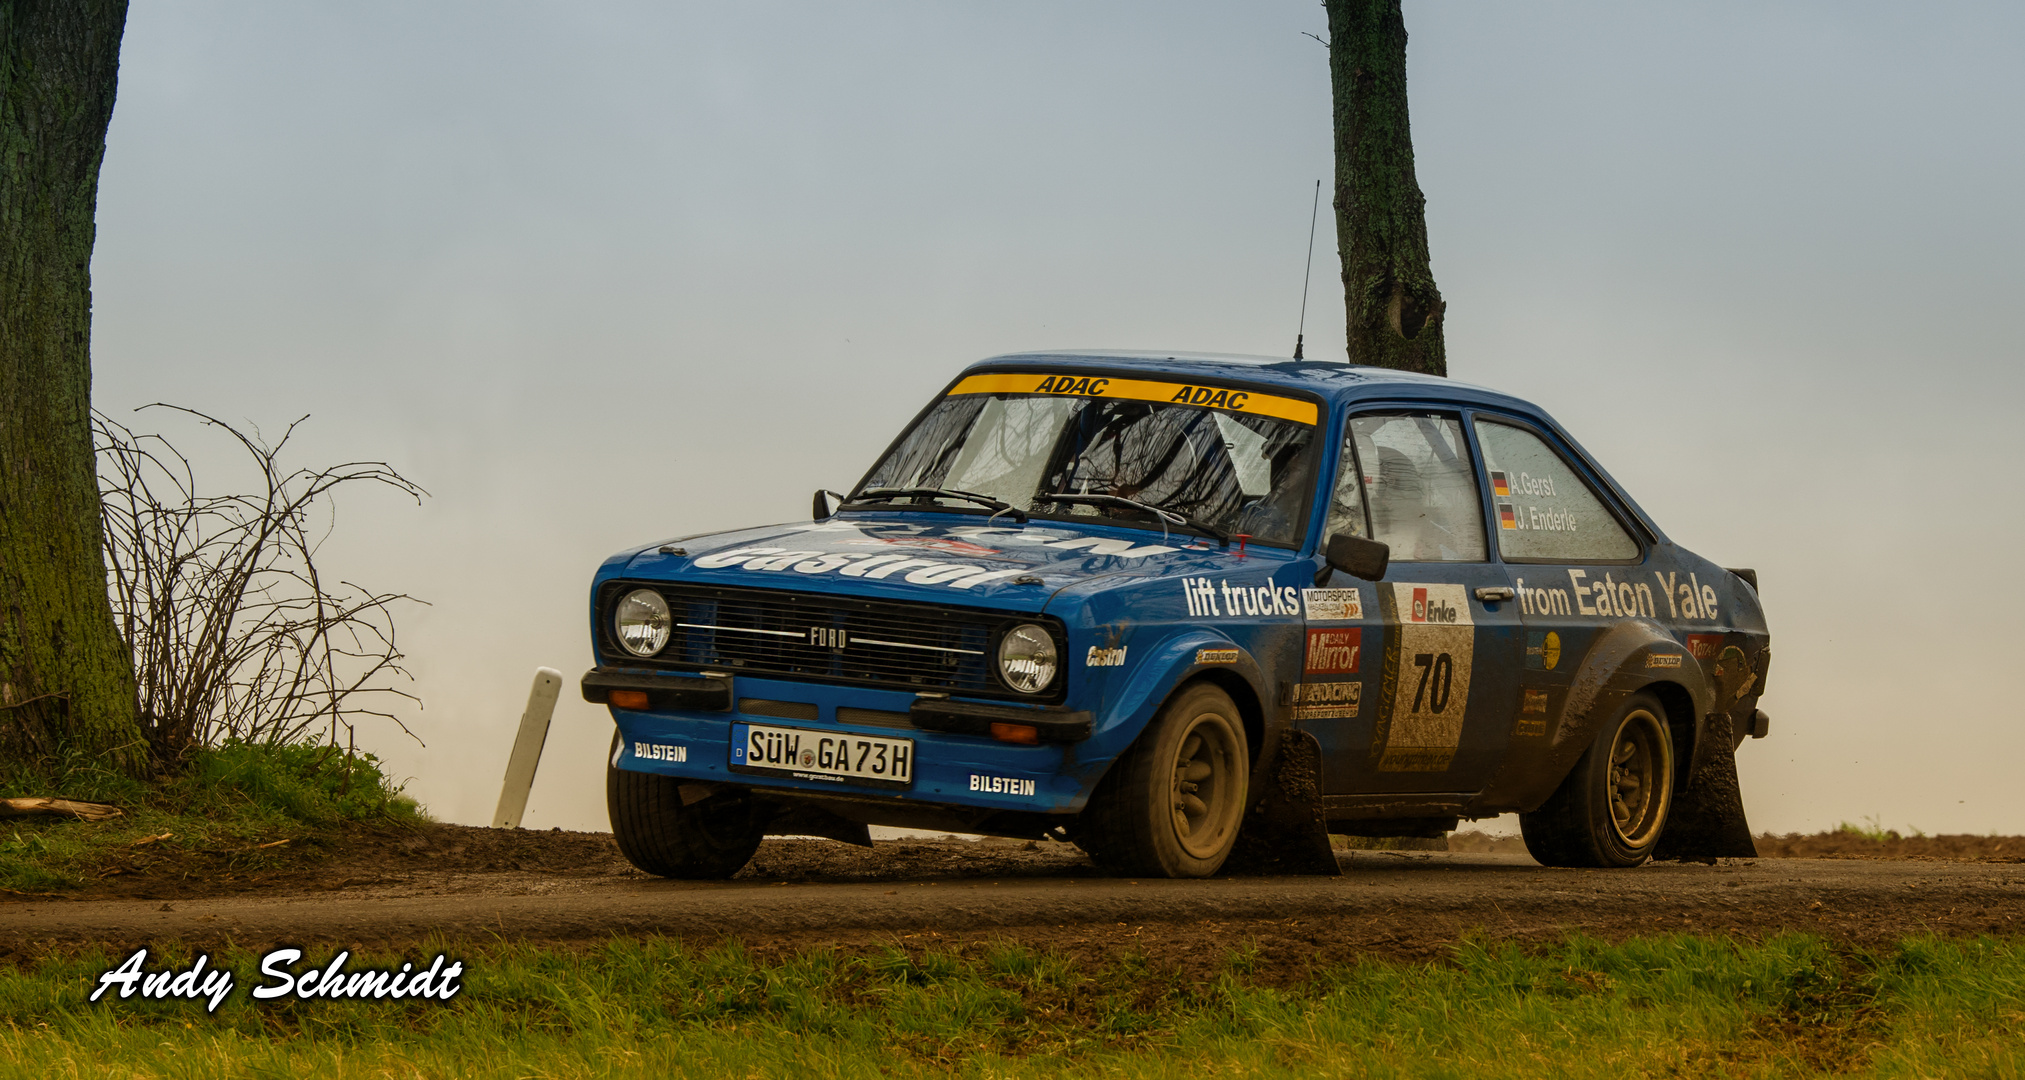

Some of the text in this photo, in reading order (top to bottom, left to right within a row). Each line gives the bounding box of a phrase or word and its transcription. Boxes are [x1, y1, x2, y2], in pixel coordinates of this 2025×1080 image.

[1035, 376, 1249, 410] ADAC ADAC
[1510, 472, 1557, 496] A.Gerst
[1517, 506, 1577, 531] J. Enderle
[694, 547, 1031, 590] Castrol
[1182, 576, 1300, 616] lift trucks
[1306, 590, 1356, 602] MOTORSPORT
[1517, 568, 1718, 620] from Eaton Yale
[1427, 600, 1457, 623] Enke
[810, 626, 846, 648] FORD
[1330, 633, 1350, 645] DAILY
[1086, 645, 1128, 667] Castrol
[1203, 652, 1237, 661] DUNLOP
[1306, 633, 1360, 670] Mirror
[1653, 656, 1680, 665] DUNLOP
[1411, 652, 1453, 714] 70
[634, 742, 687, 762] BILSTEIN
[736, 748, 743, 757] D
[749, 731, 800, 765] SÜW
[969, 774, 1035, 796] BILSTEIN
